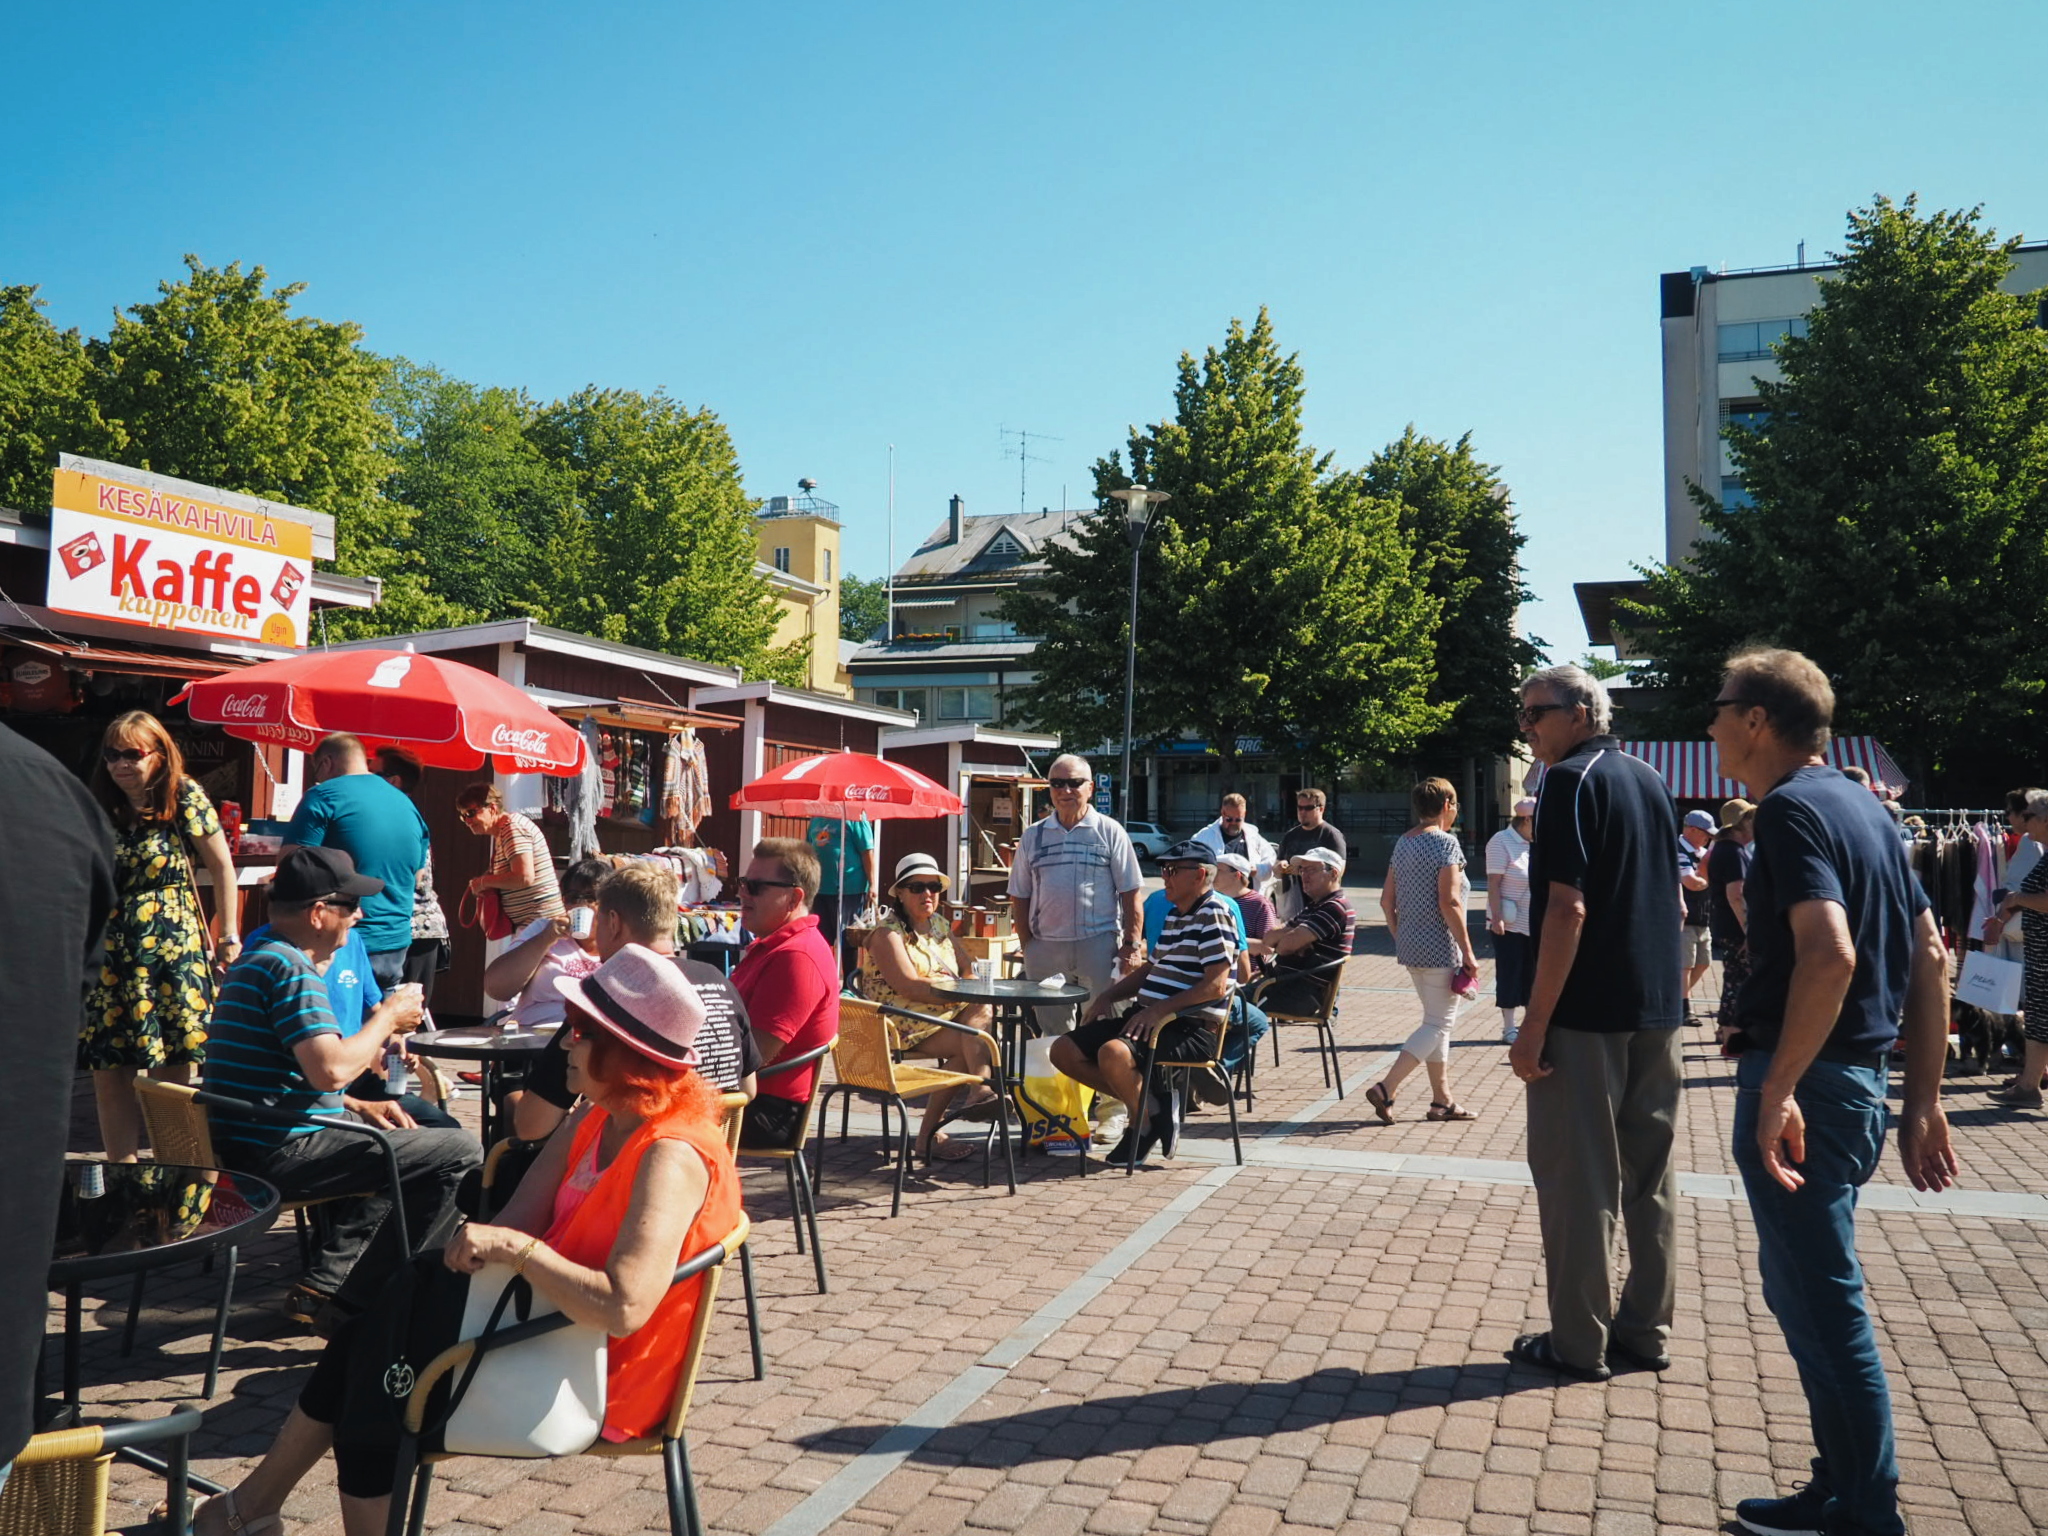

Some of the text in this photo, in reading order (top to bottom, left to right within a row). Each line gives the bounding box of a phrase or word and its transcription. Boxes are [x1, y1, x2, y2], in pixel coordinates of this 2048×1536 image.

[98, 483, 278, 547] KESÄKAHVILA
[110, 533, 261, 619] Kaffe
[118, 581, 249, 630] kupponen
[1099, 775, 1109, 787] P
